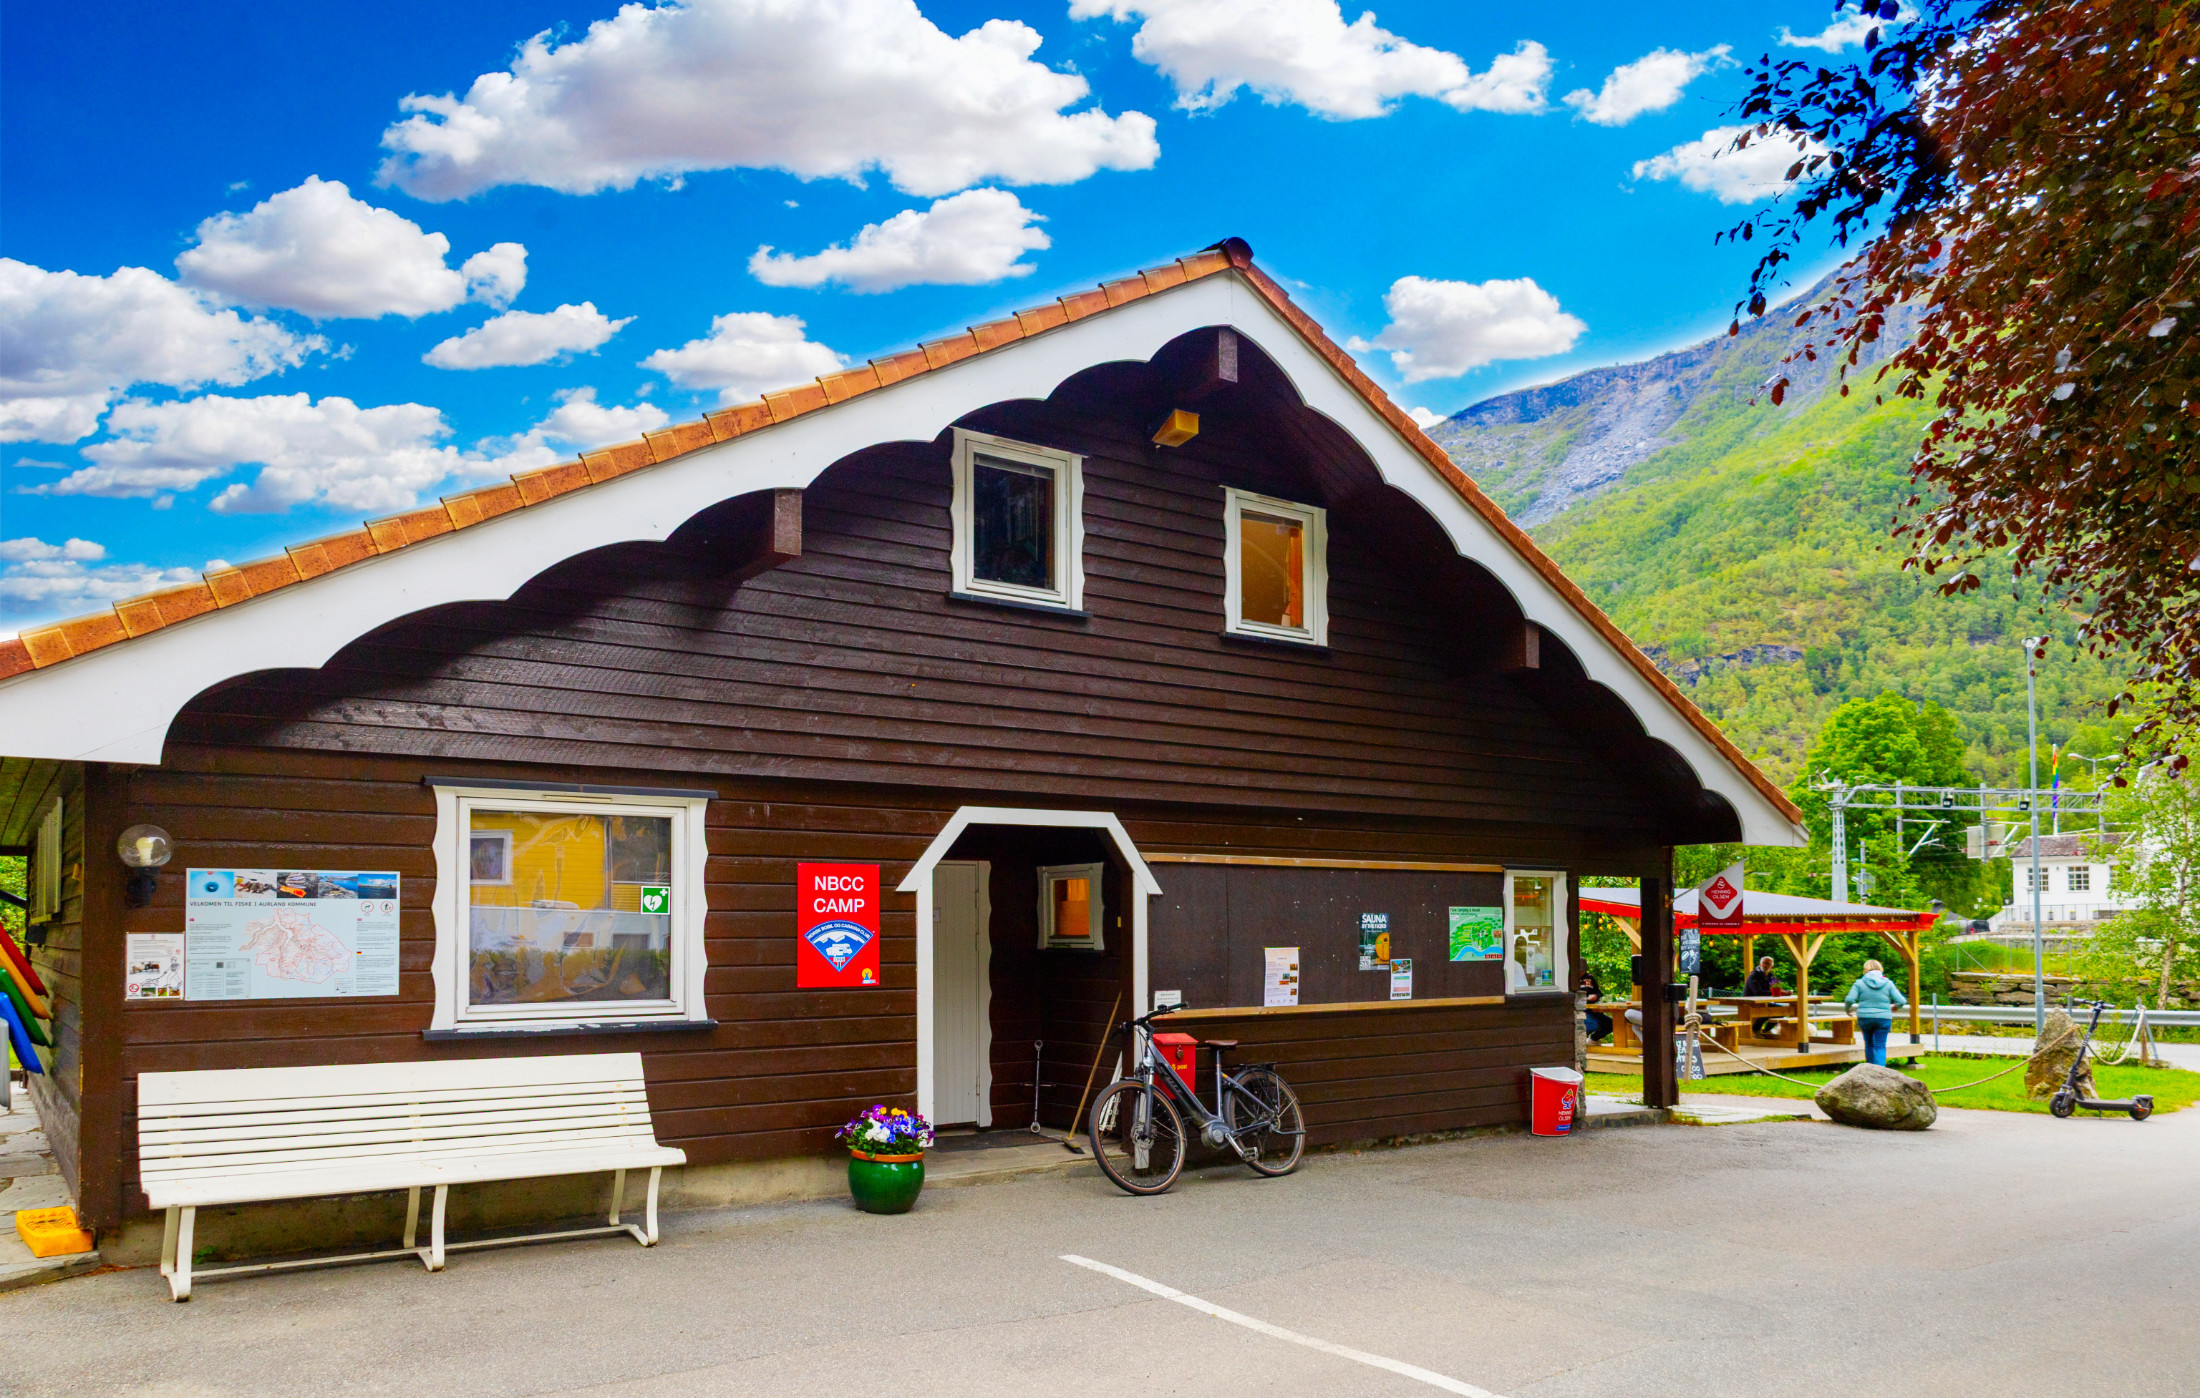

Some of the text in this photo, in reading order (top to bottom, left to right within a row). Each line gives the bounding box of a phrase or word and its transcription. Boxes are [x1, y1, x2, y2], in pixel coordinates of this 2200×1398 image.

[814, 875, 864, 891] NBCC
[813, 898, 865, 913] CAMP
[1361, 914, 1387, 923] SAUNA
